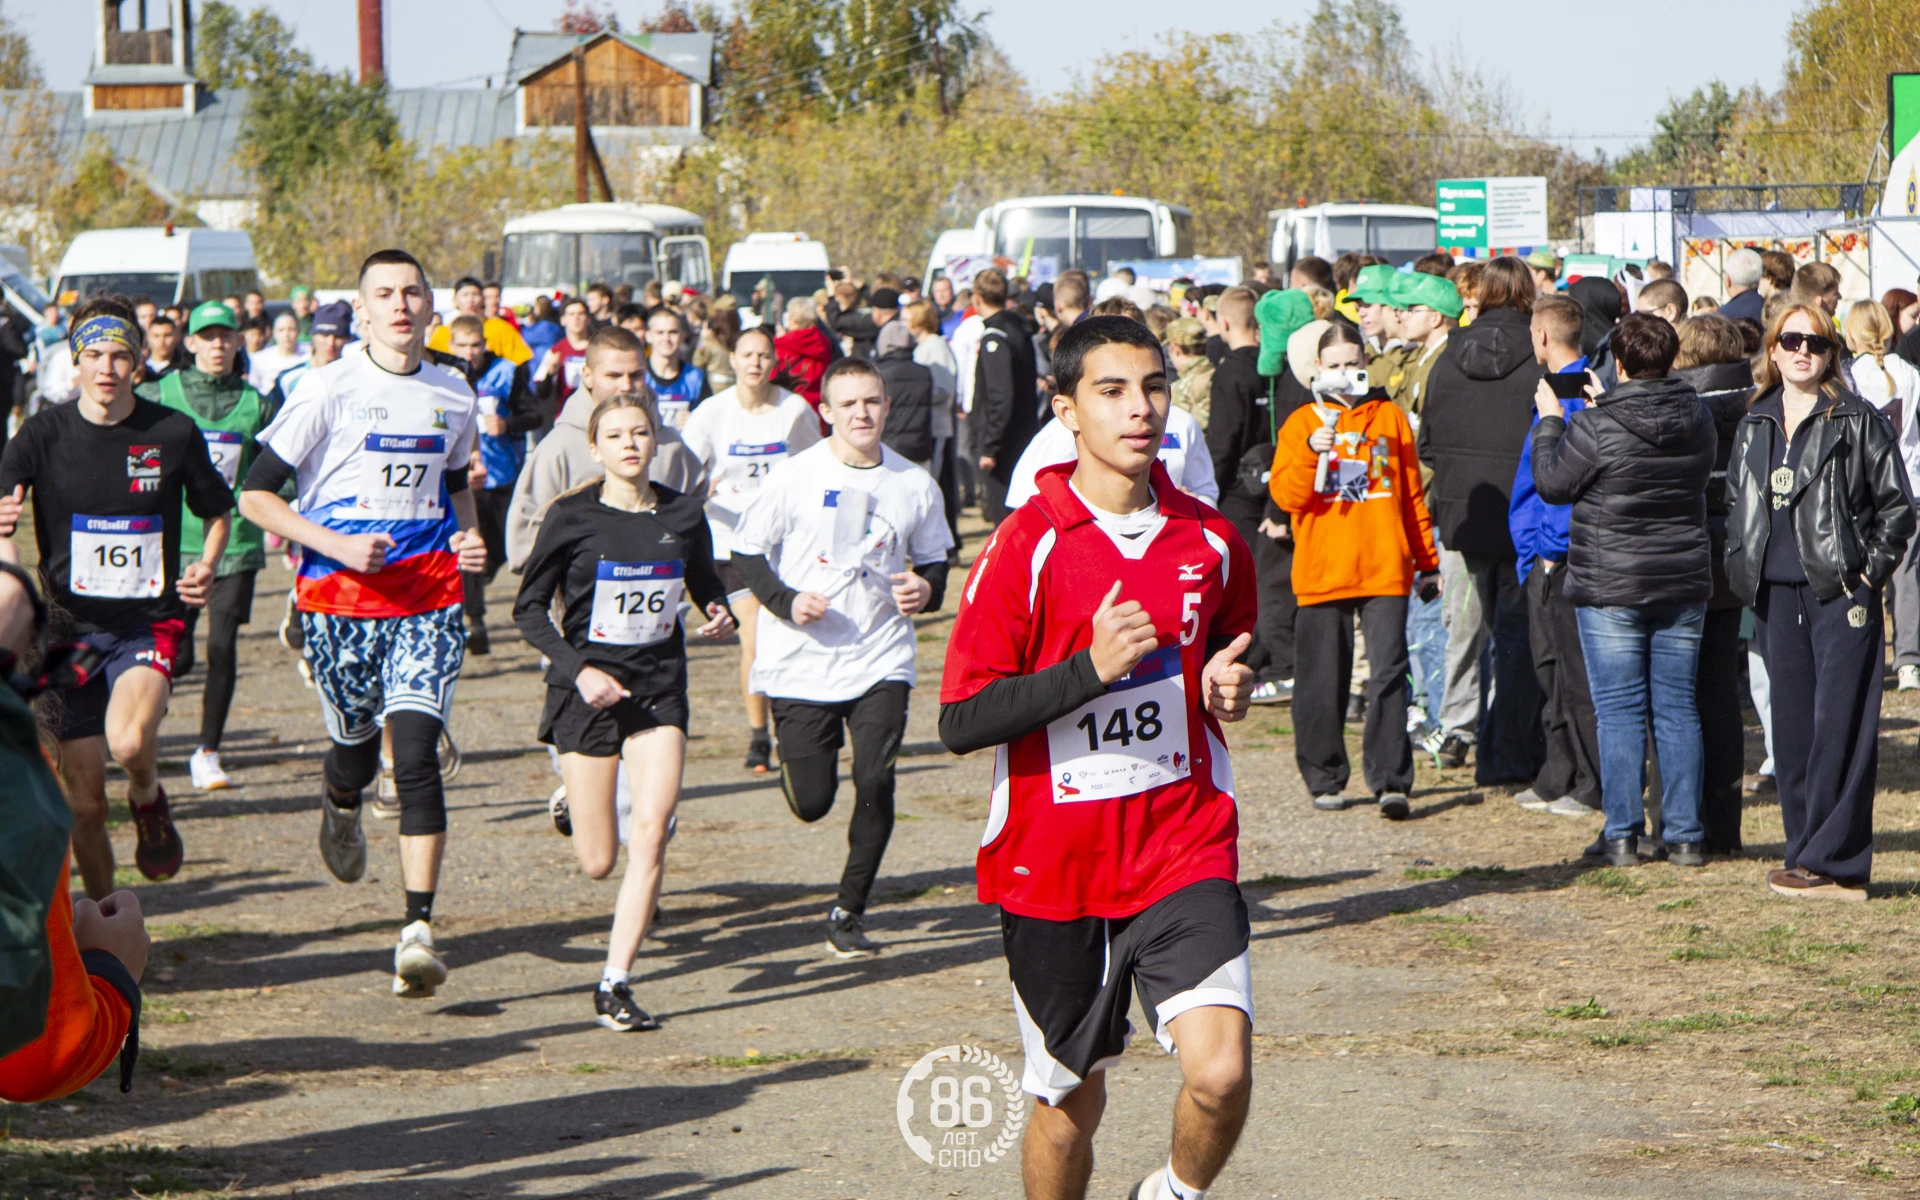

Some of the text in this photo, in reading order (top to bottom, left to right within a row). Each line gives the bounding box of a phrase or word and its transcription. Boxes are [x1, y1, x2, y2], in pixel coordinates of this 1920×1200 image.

[381, 463, 428, 488] 127
[94, 545, 142, 568] 161
[614, 590, 665, 615] 126
[1180, 592, 1201, 646] 5
[1077, 700, 1163, 751] 148
